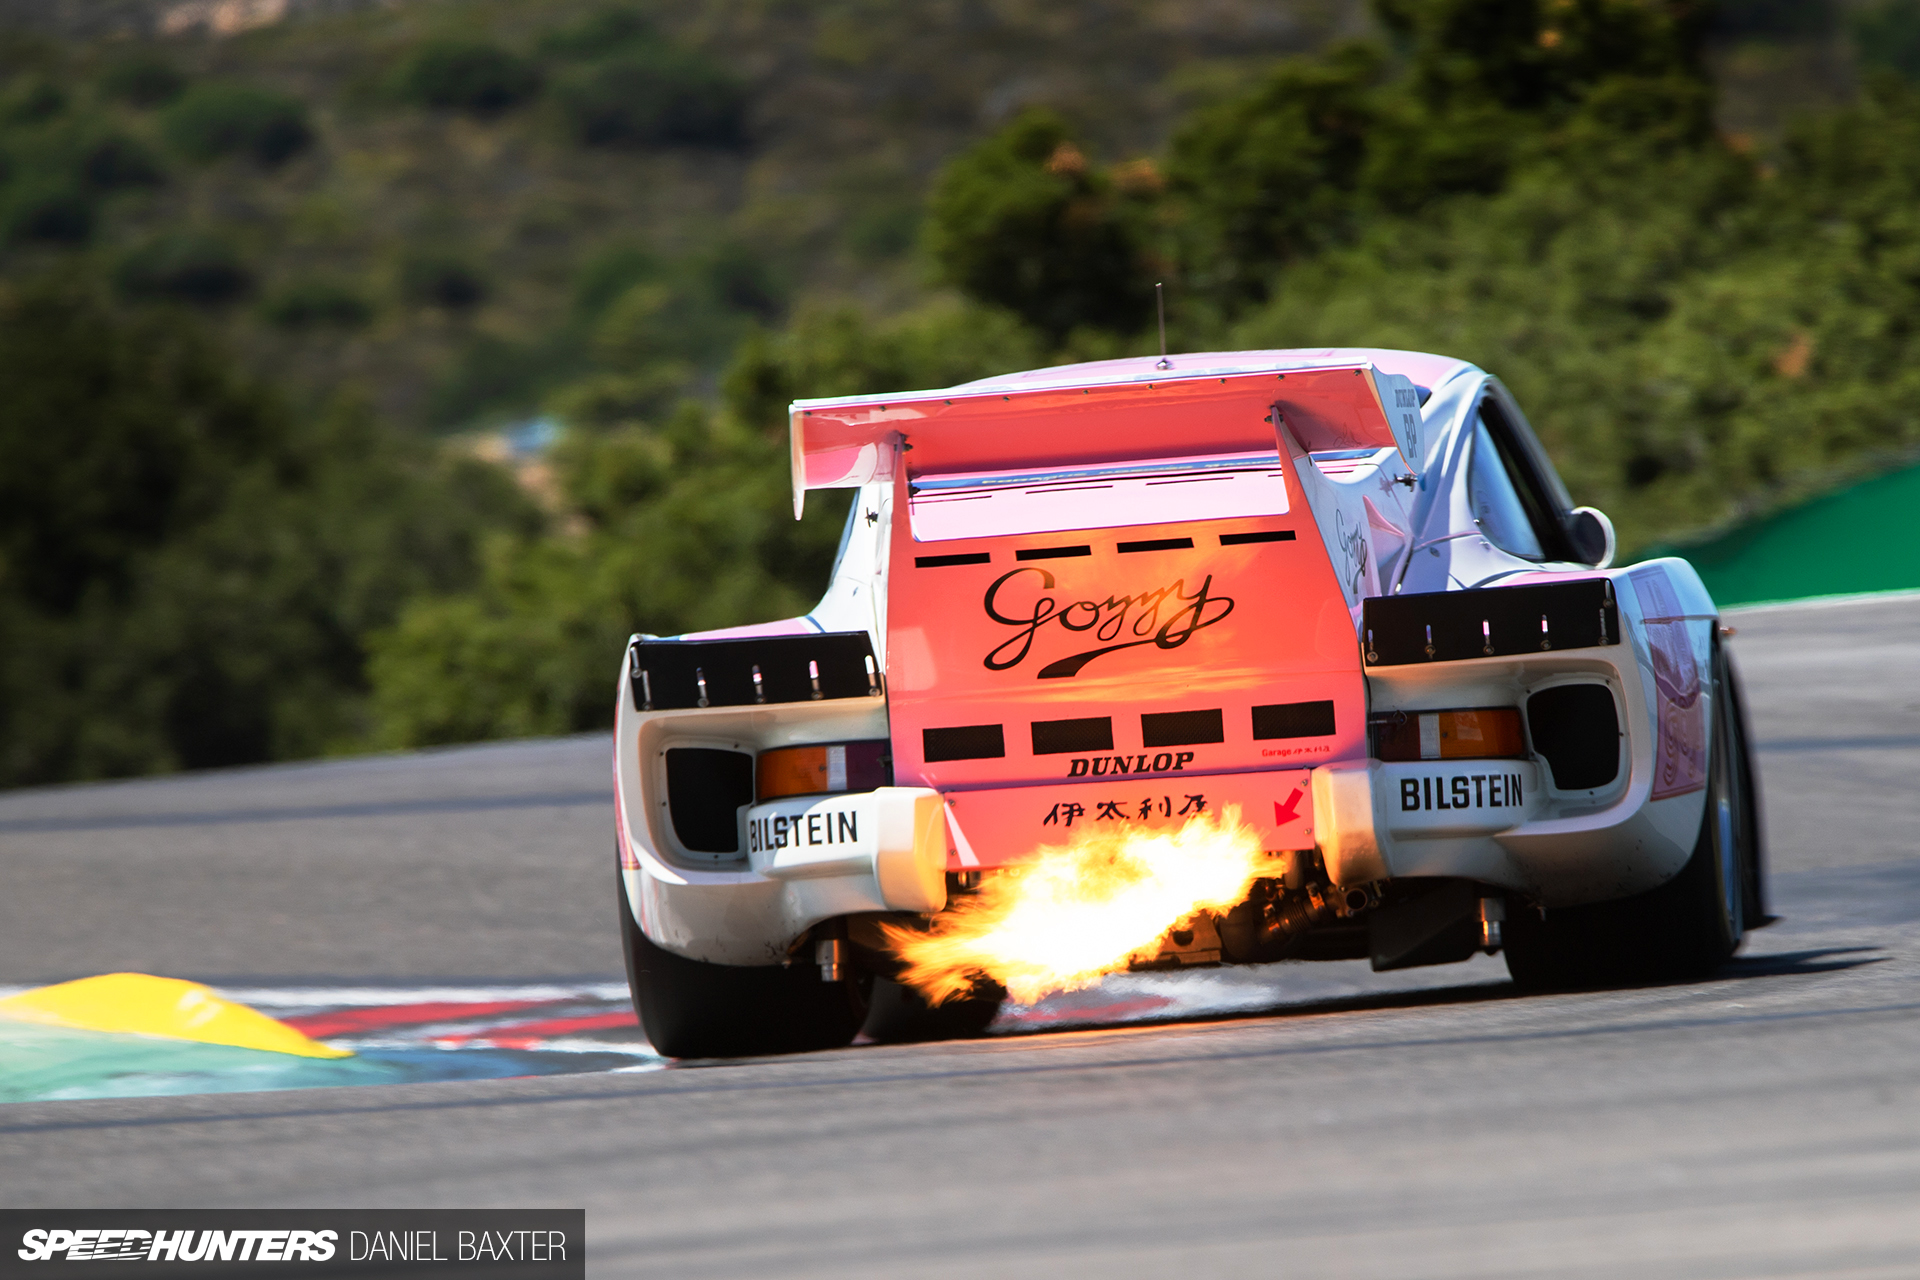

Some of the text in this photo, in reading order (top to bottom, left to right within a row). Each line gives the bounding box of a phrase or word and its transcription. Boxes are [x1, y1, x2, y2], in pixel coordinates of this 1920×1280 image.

[1403, 414, 1418, 459] BP
[1067, 752, 1194, 777] DUNLOP
[1262, 748, 1292, 757] Garage
[1400, 773, 1523, 811] BILSTEIN
[749, 810, 858, 853] BILSTEIN
